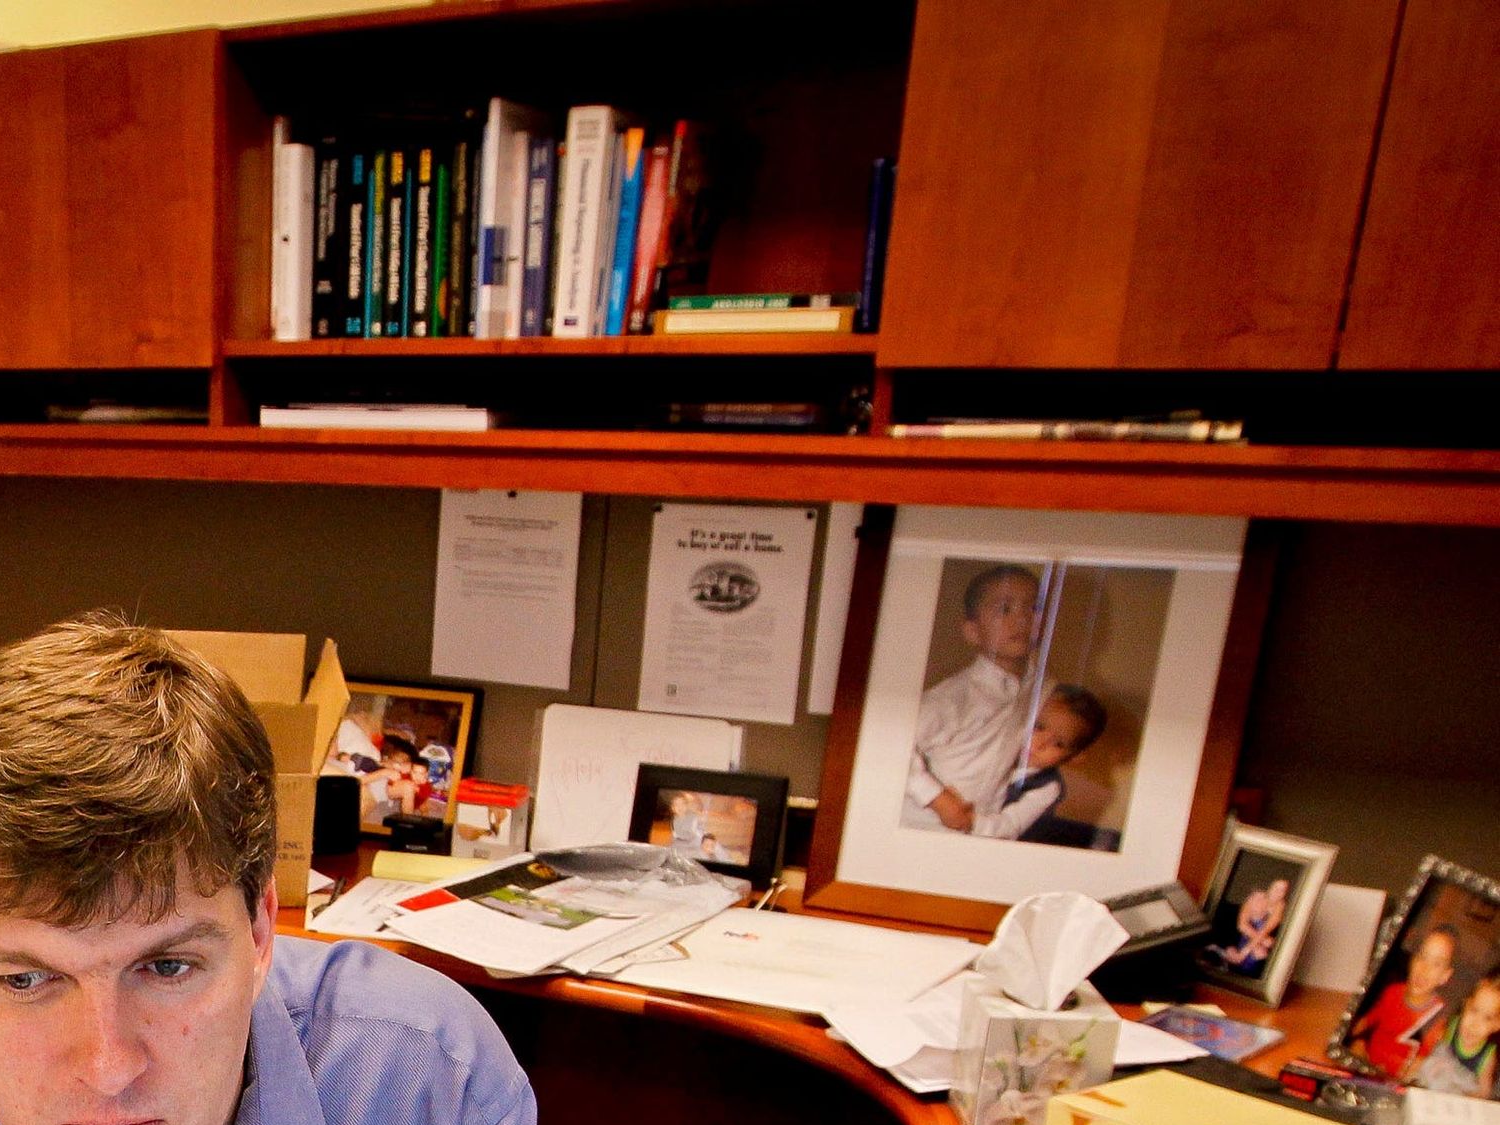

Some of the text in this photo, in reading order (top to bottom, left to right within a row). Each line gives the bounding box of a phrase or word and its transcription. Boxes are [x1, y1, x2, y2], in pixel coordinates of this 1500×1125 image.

[719, 530, 746, 542] great
[750, 532, 774, 542] time
[690, 541, 707, 551] buy
